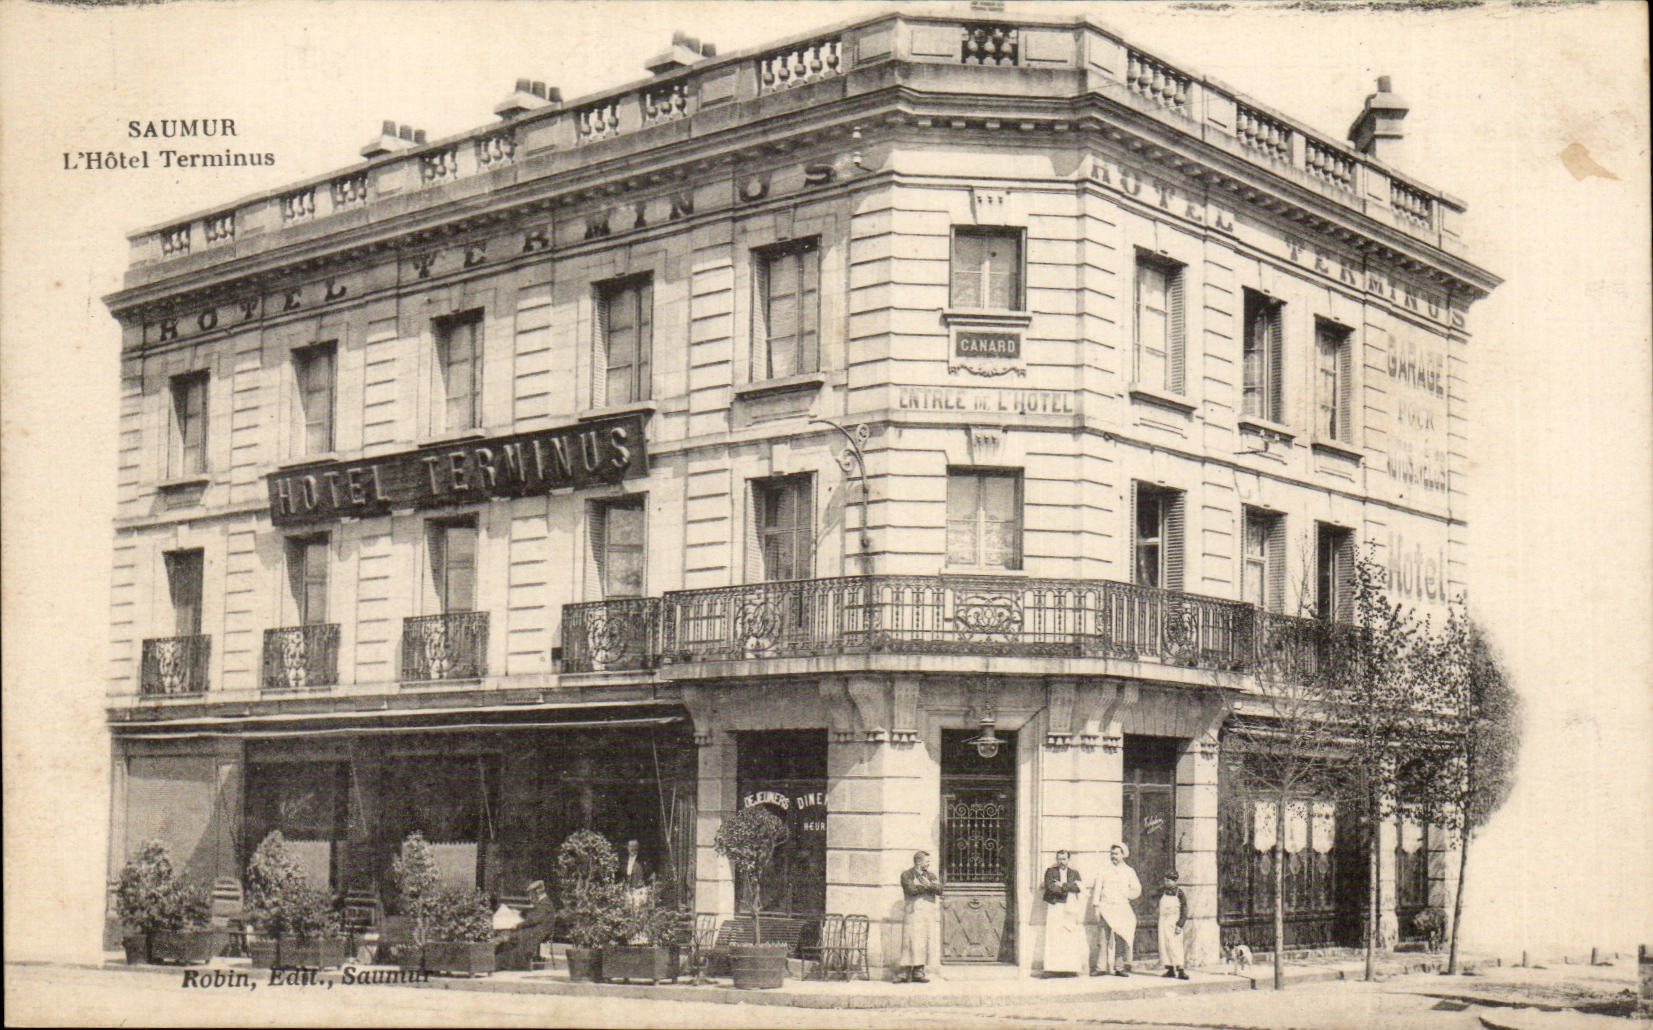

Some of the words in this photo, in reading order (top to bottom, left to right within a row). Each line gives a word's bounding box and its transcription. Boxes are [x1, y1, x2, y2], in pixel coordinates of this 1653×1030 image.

[960, 338, 1016, 353] CANARD
[1387, 333, 1444, 399] GARAGE
[276, 464, 390, 515] HOTEL
[421, 427, 632, 496] TERMINUS
